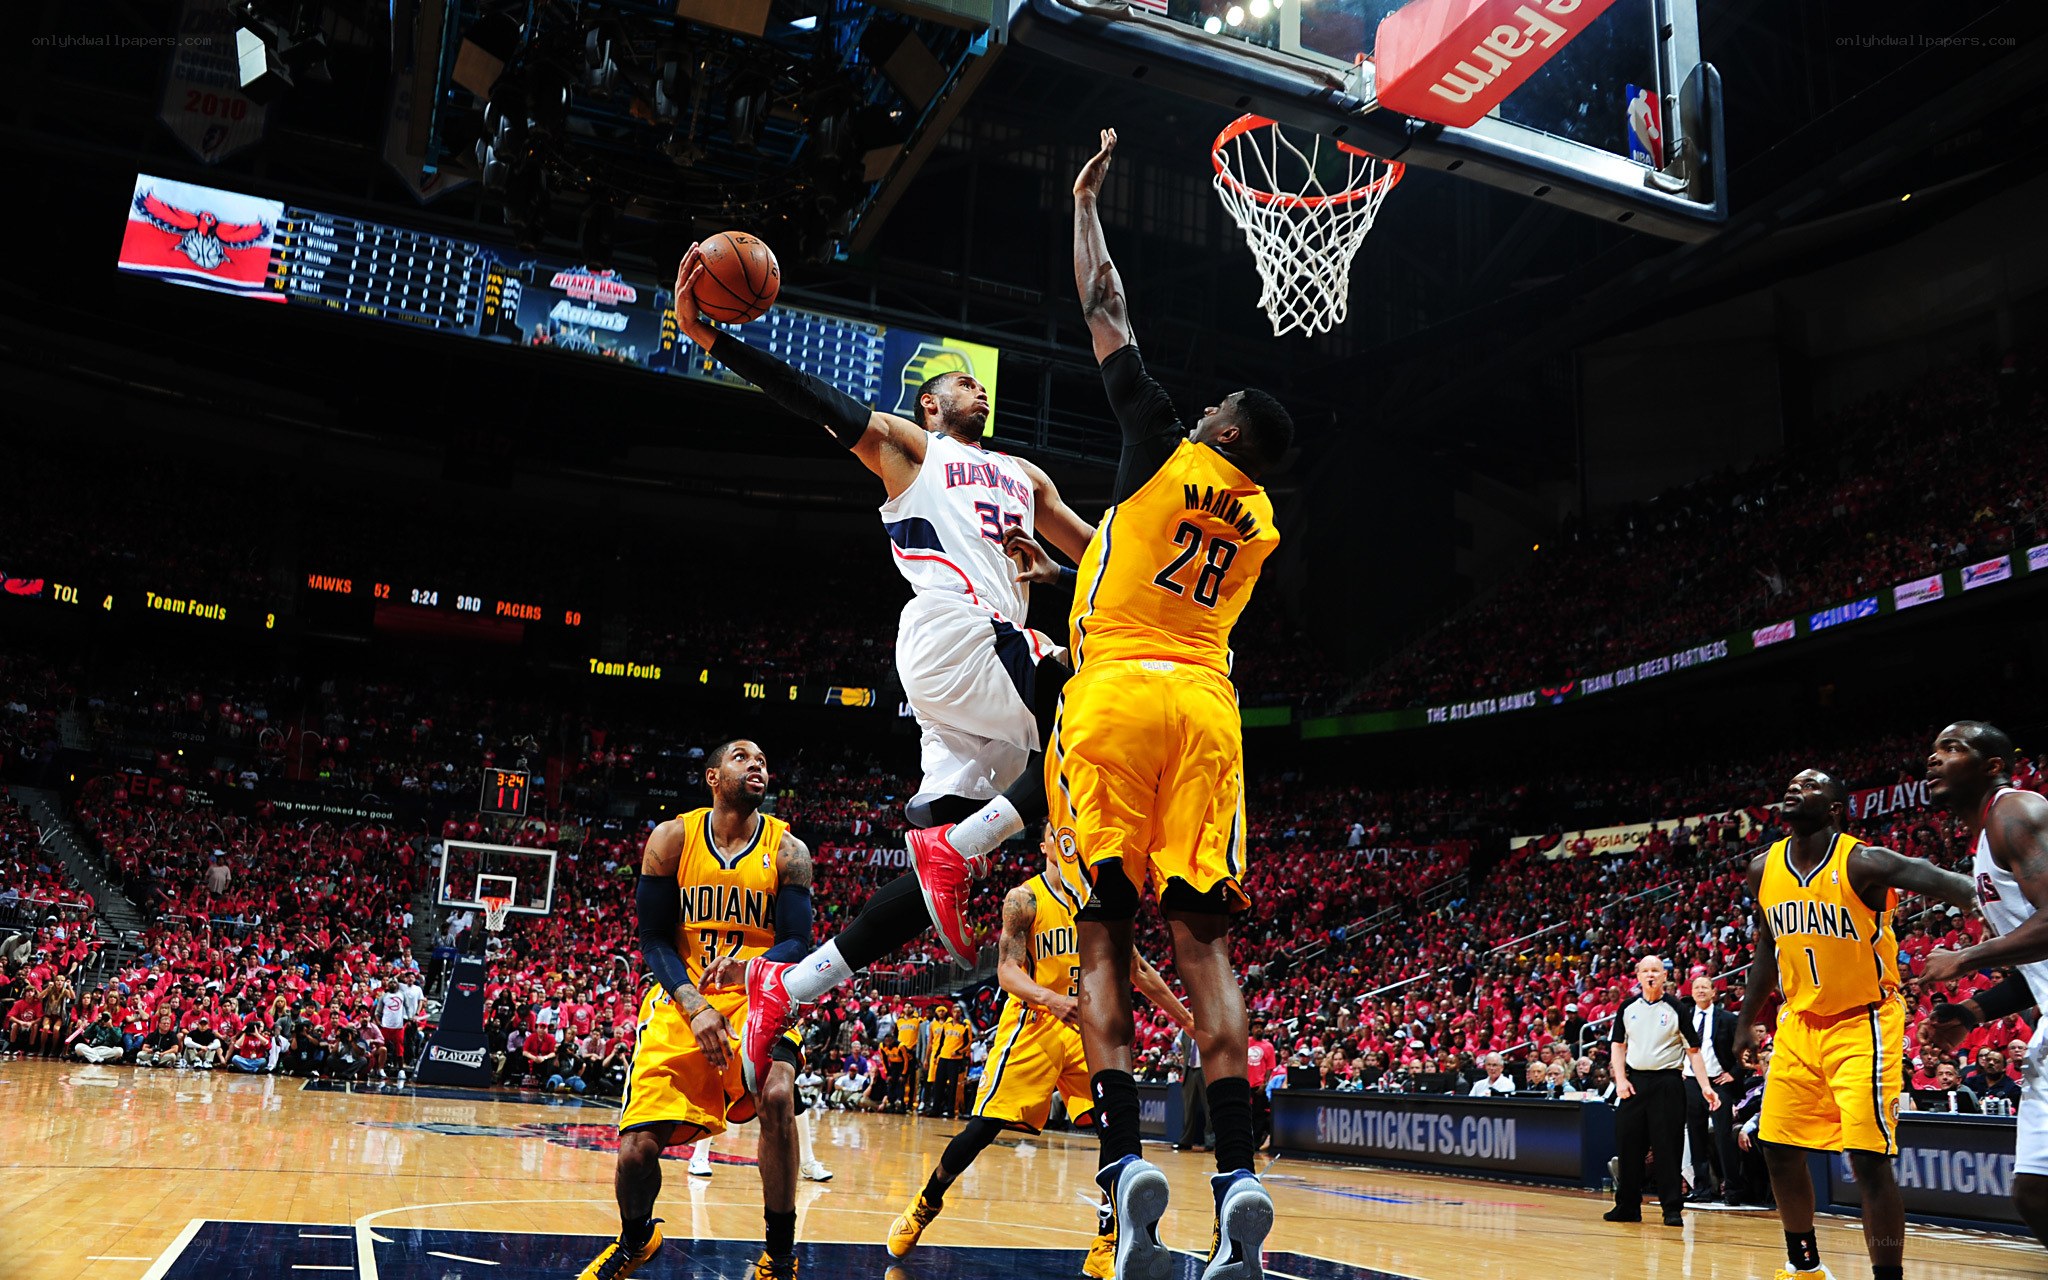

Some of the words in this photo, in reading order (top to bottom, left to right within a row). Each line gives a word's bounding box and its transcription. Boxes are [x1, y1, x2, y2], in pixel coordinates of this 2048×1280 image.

[185, 90, 246, 121] 2010
[1632, 149, 1652, 165] NBA
[306, 236, 339, 252] Williams
[309, 221, 335, 237] Teague
[301, 264, 325, 279] Korver
[304, 250, 331, 266] Millsap
[554, 274, 596, 291] ATLANTA
[599, 279, 635, 301] HAWKS
[550, 300, 630, 332] Aaron's
[1152, 520, 1239, 609] 28
[53, 584, 79, 604] TOL
[103, 595, 113, 611] 4
[146, 592, 186, 613] Team
[188, 600, 227, 620] Fouls
[266, 614, 275, 629] 3
[308, 574, 352, 594] HAWKS
[411, 588, 439, 606] 3:24
[456, 595, 481, 612] 3RD
[496, 601, 541, 620] PACERS
[589, 658, 625, 676] Team
[627, 662, 661, 680] Fouls
[699, 669, 708, 684] 4
[743, 683, 765, 699] TOL
[1427, 706, 1448, 724] THE
[1450, 699, 1496, 720] ATLANTA
[1499, 691, 1536, 713] HAWKS
[1581, 672, 1614, 696] THANK
[1616, 666, 1636, 687] OUR
[1638, 656, 1670, 680] GREEN
[1672, 639, 1728, 671] PARTNERS
[497, 772, 525, 788] 3:24
[272, 800, 292, 810] ning
[295, 803, 320, 812] never
[323, 805, 353, 815] looked
[356, 809, 367, 817] so
[497, 787, 519, 810] 11
[681, 884, 776, 931] NDIANA
[1766, 899, 1861, 942] INDIANA
[1035, 927, 1079, 960] INDI
[1804, 947, 1820, 987] 1
[435, 1048, 484, 1063] PLAYOFFS
[1326, 1107, 1517, 1161] NBATICKETS.COM
